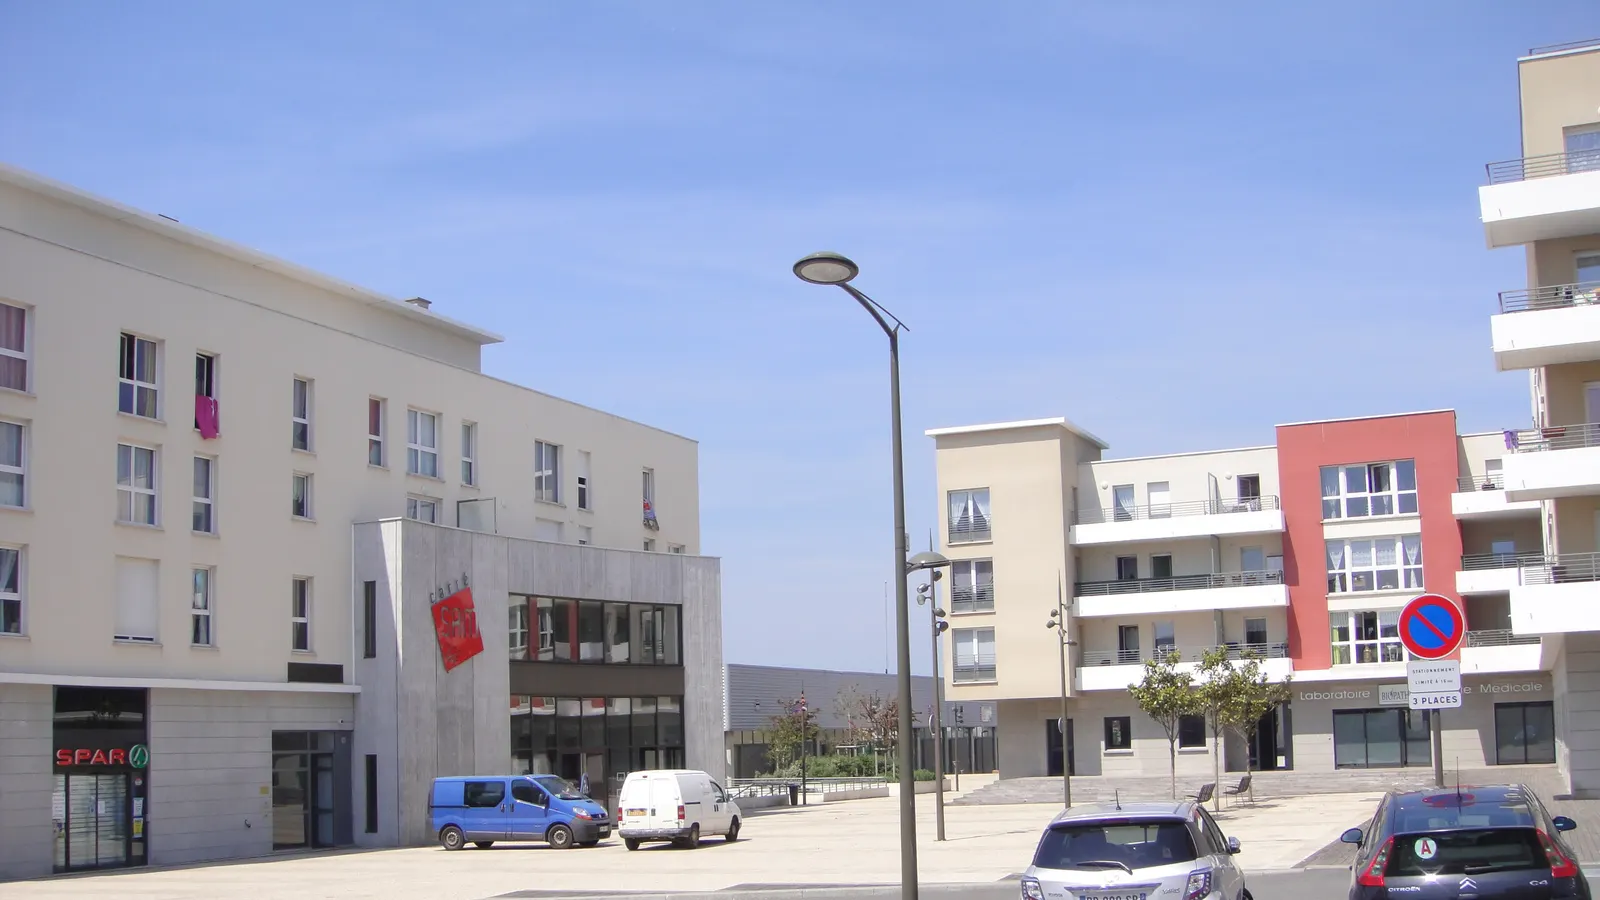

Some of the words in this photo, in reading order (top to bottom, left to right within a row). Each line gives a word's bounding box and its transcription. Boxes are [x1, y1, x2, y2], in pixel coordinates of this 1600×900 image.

[1299, 689, 1371, 701] Laboratoire
[1412, 697, 1419, 705] 3
[1421, 695, 1458, 704] PLACES
[56, 748, 126, 766] SPAR
[1421, 840, 1432, 855] A
[1529, 879, 1549, 887] C4
